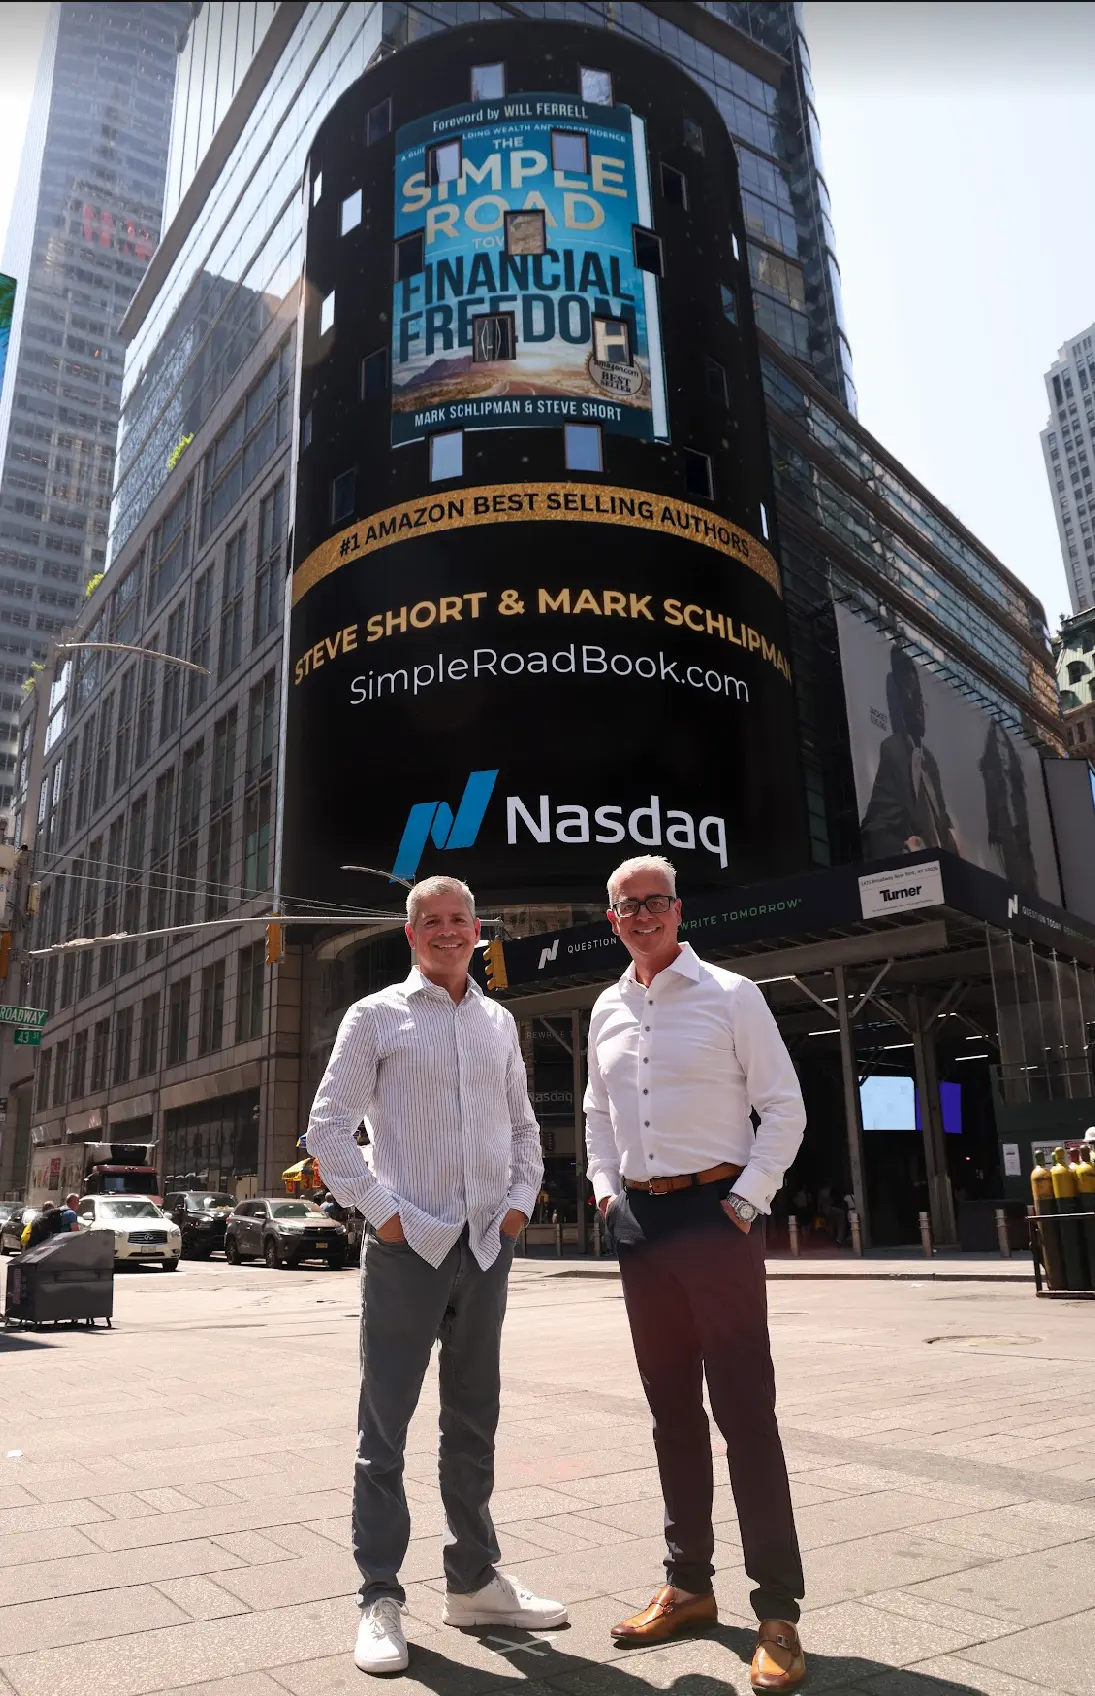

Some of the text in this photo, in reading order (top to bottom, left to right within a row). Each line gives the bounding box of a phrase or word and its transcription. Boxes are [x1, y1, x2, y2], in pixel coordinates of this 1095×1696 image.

[433, 103, 589, 133] Foreword by WILL FERRELL
[493, 124, 530, 135] WEALTH
[492, 136, 523, 150] THE
[426, 191, 605, 245] ROAD
[402, 249, 635, 312] FINANCIAL
[600, 380, 631, 393] SELLER
[602, 372, 631, 386] BEST
[415, 399, 622, 426] MARK SCHLIPMAN & STEVE SHORT
[338, 492, 750, 557] #1 AMAZON BEST SELLING AUTHORS
[294, 588, 792, 686] STEVE SHORT & MARK SCHLIPMAN
[349, 644, 750, 705] SimpleRoadBook.com
[506, 795, 728, 869] Nasdaq
[880, 885, 922, 902] Turner
[680, 916, 716, 931] WRITE
[1022, 906, 1046, 924] QUESTION
[568, 937, 617, 954] QUESTION
[0, 1006, 44, 1024] ROADWAY
[18, 1031, 29, 1043] 43
[526, 1031, 564, 1039] REWRE
[527, 1090, 572, 1104] Nasdaq
